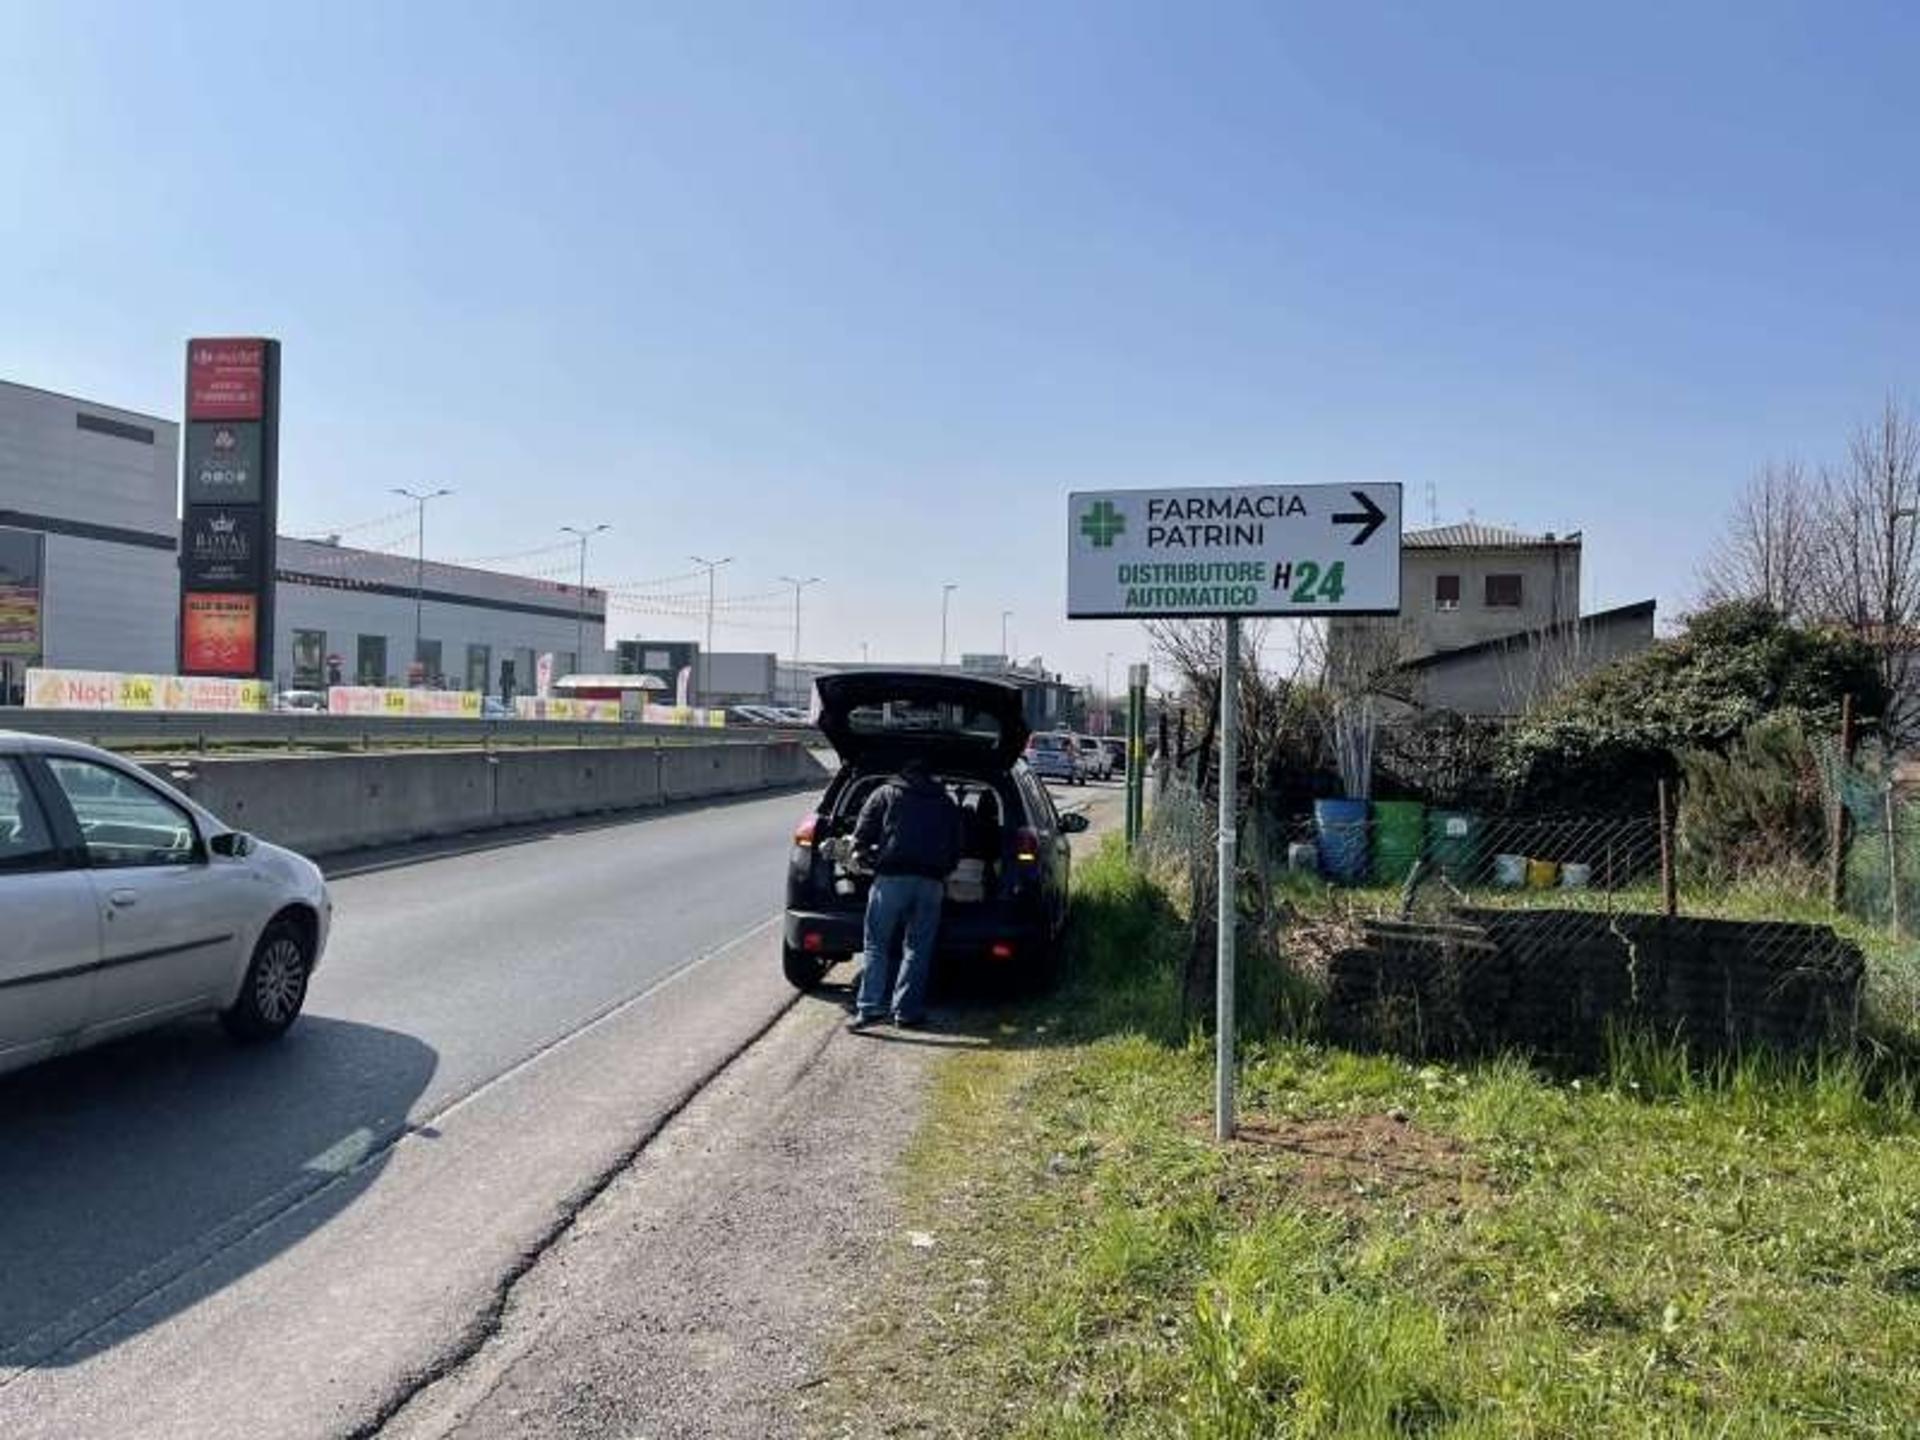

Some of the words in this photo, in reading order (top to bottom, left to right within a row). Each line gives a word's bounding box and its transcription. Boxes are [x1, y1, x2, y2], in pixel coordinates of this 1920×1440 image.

[1147, 494, 1307, 521] FARMACIA
[1147, 522, 1264, 549] PATRINI
[1118, 561, 1265, 585] DISTRIBUTORE
[1125, 586, 1258, 608] AUTOMATICO
